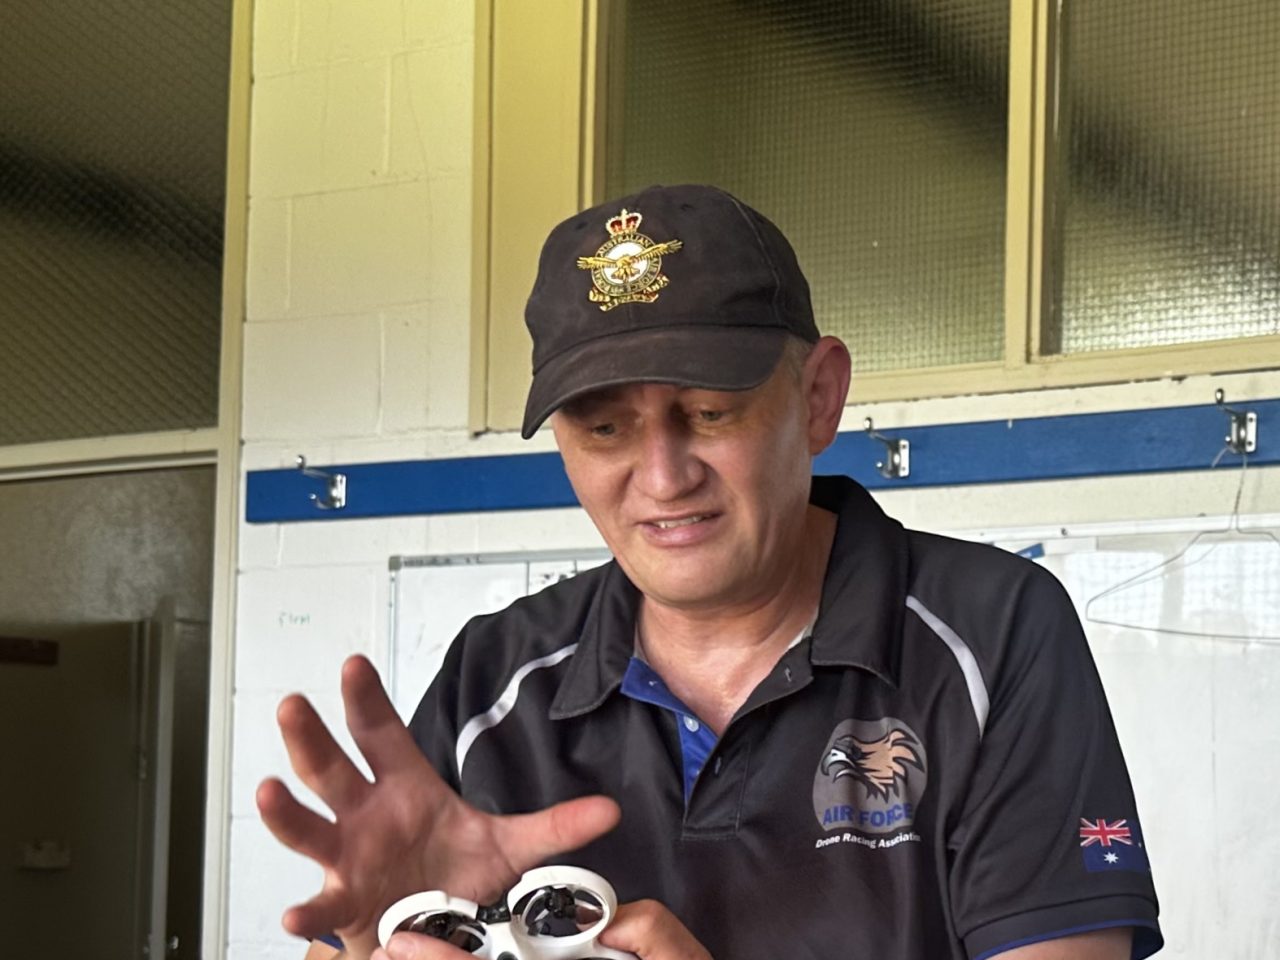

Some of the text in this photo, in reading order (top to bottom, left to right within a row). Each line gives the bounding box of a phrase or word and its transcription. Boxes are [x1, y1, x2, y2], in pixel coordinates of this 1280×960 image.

[598, 234, 651, 258] AUSTRALIAN
[822, 802, 913, 829] AIR FORCE
[815, 835, 841, 849] Drone
[842, 832, 877, 849] Racing
